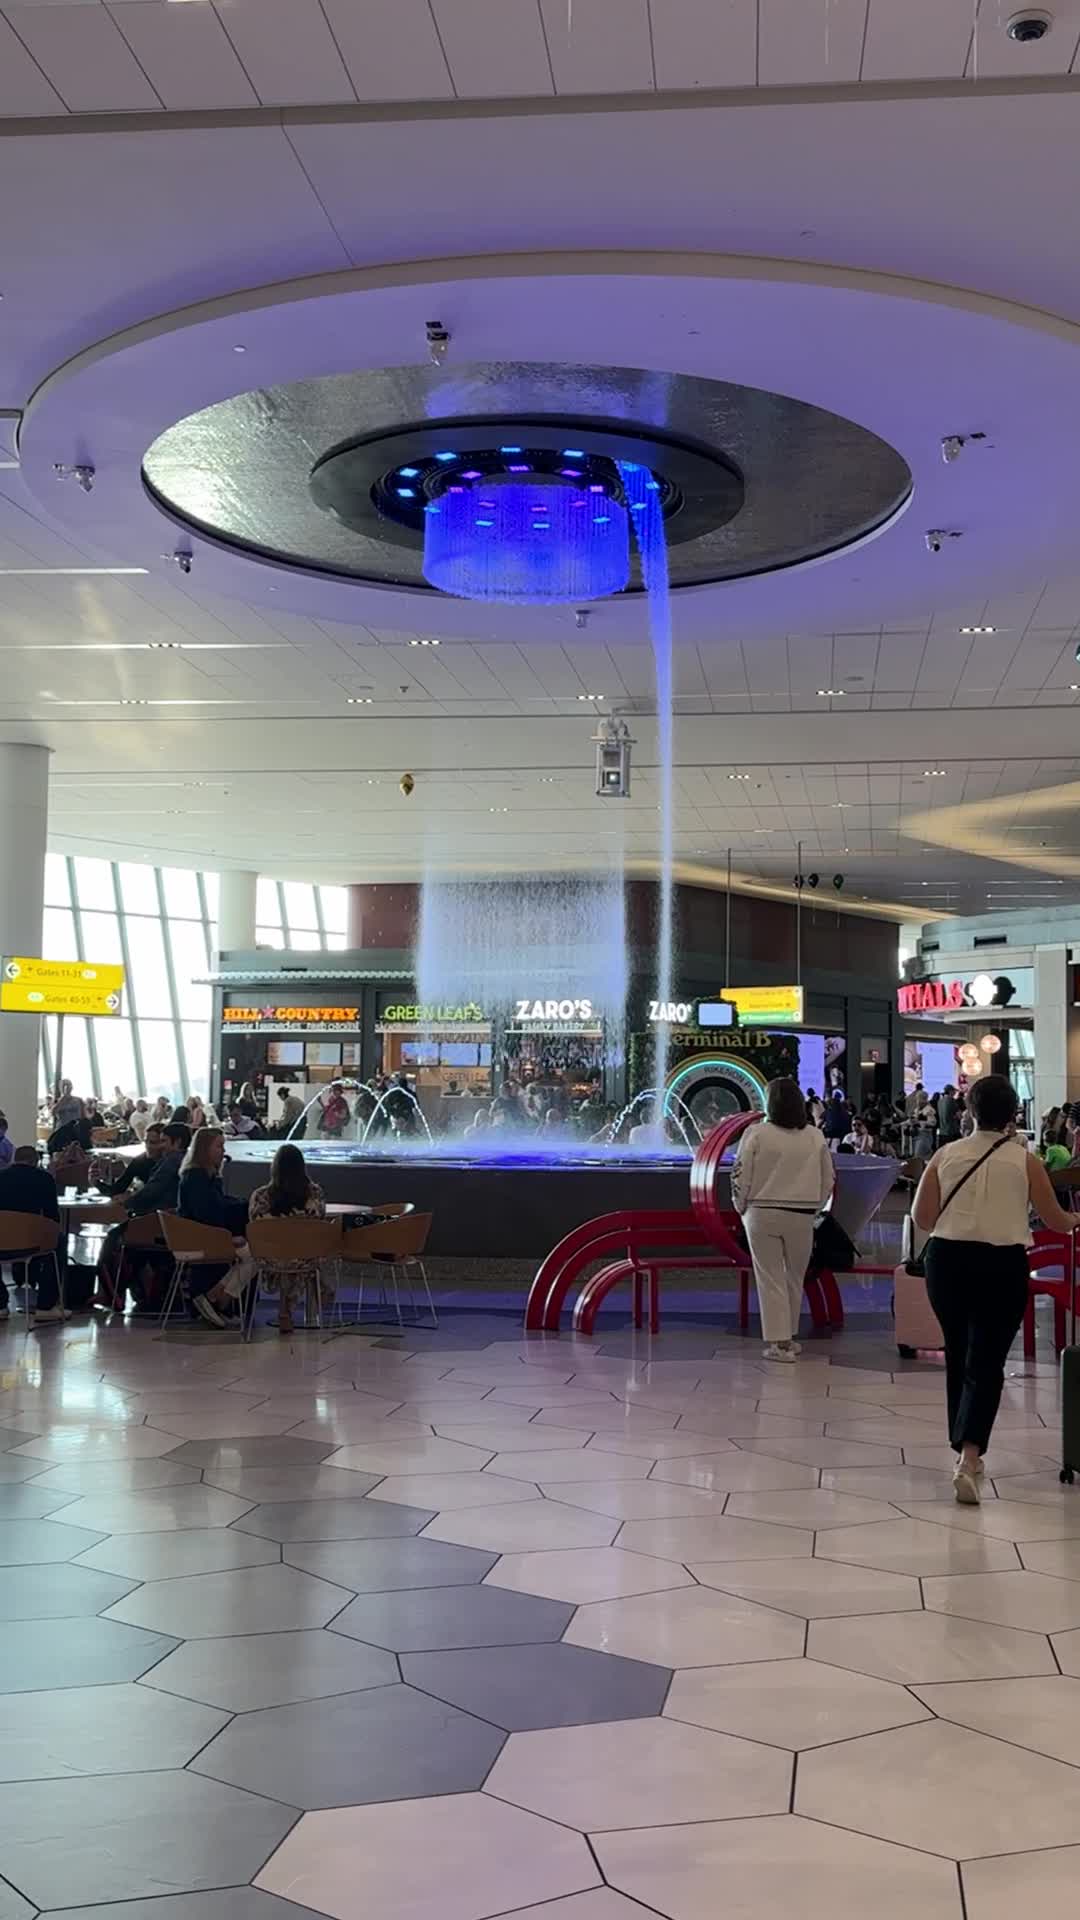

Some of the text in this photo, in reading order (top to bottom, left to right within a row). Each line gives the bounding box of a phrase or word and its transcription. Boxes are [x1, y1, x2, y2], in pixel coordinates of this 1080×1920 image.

[36, 968, 59, 977] Gates
[223, 1007, 360, 1021] HILL COUNTRY
[384, 1006, 434, 1021] GREEN
[516, 1000, 592, 1020] ZARO'S
[649, 1001, 692, 1023] ZARO'
[671, 1030, 772, 1047] erminal B
